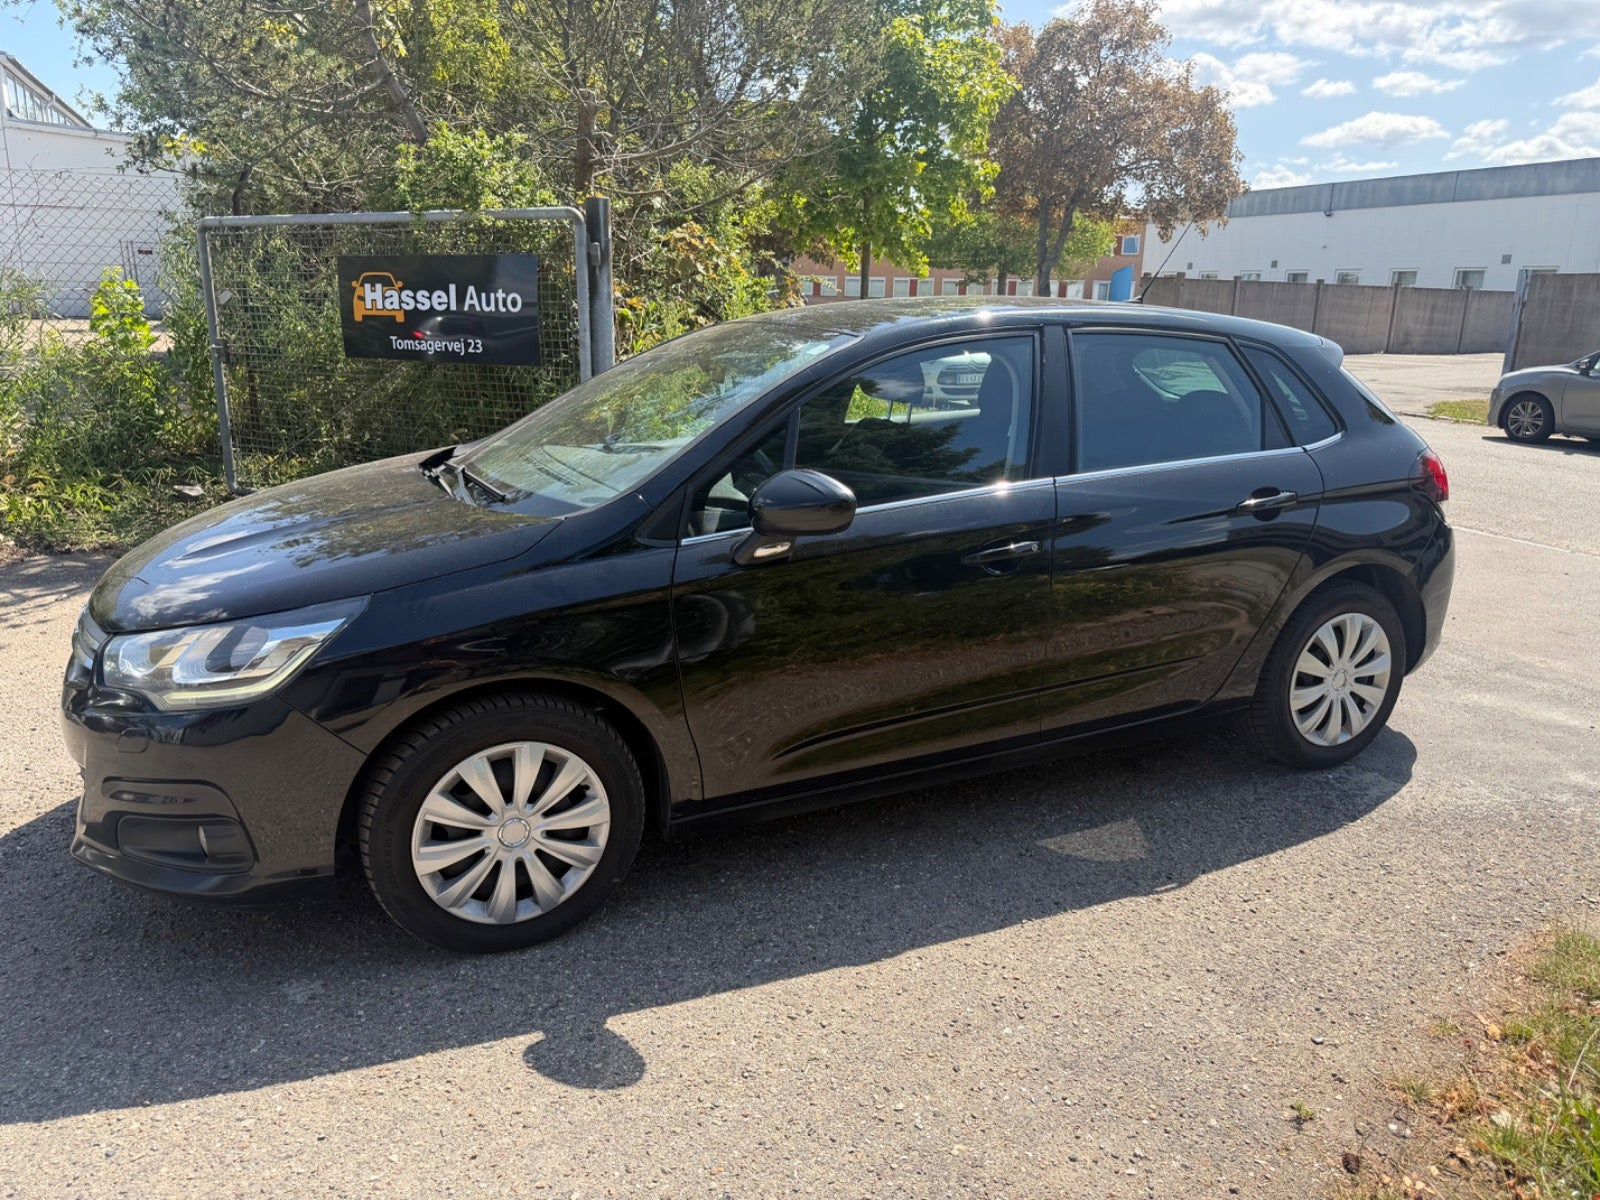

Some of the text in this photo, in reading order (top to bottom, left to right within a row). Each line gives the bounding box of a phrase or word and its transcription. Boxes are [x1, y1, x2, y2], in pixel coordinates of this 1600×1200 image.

[364, 283, 522, 313] Hassel Auto
[390, 335, 483, 355] Tomsagervej 23
